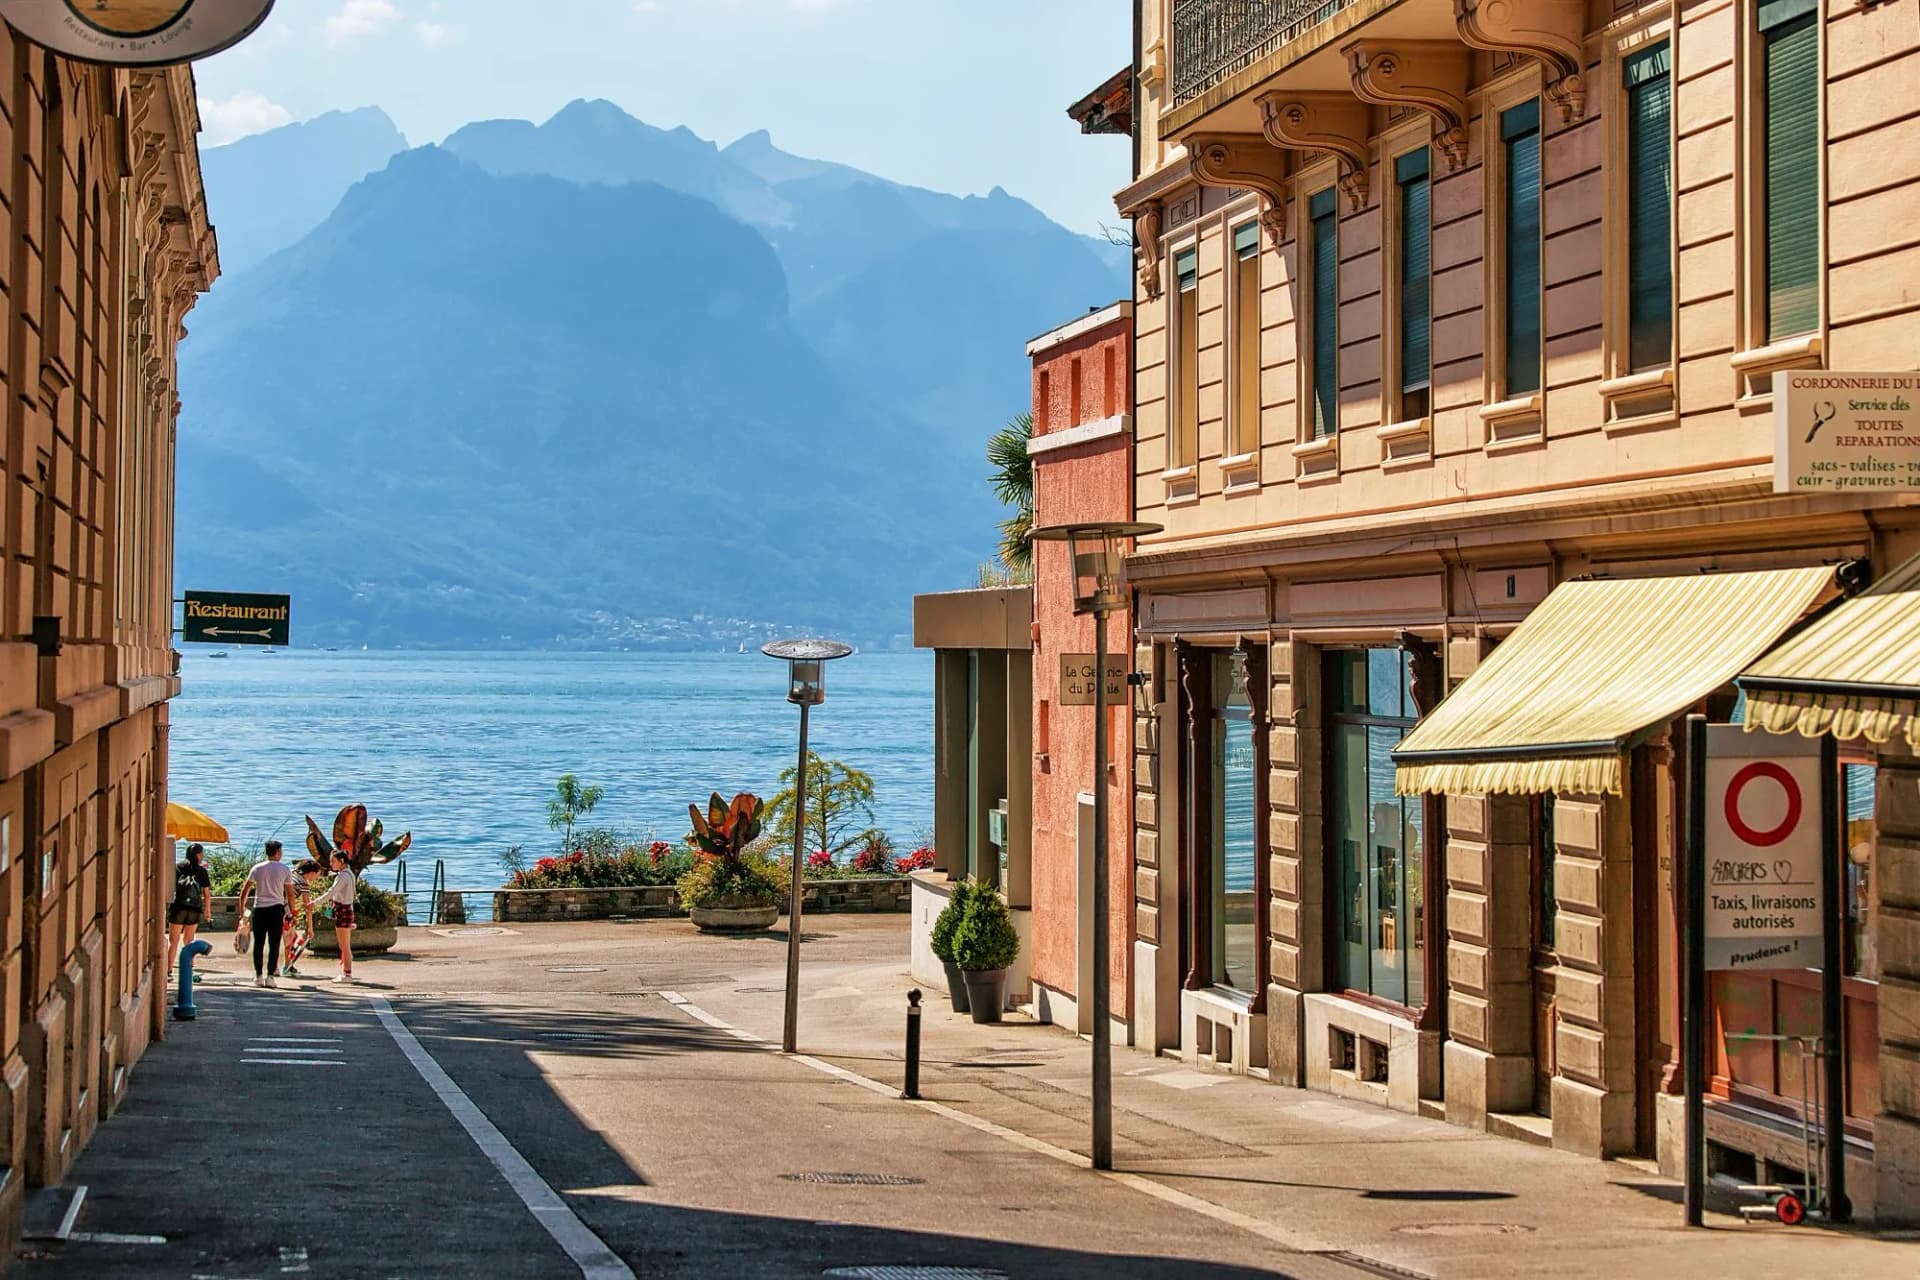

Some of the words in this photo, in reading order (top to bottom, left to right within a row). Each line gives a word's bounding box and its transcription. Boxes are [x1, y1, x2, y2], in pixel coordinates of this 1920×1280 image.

[64, 17, 115, 50] Restaurant
[129, 41, 147, 51] Bar
[160, 17, 193, 45] Lounge
[1792, 378, 1889, 389] CORDONNERIE
[1893, 378, 1912, 389] DU
[1849, 398, 1887, 411] Service
[1856, 420, 1903, 431] TOUTES
[1811, 461, 1838, 472] sacs
[1850, 455, 1896, 472] valises
[1797, 473, 1823, 486] cuir
[1835, 476, 1896, 490] gravures
[187, 600, 288, 620] Restaurant
[1066, 666, 1077, 678] La
[1068, 682, 1082, 694] du
[1712, 896, 1748, 911] Taxis,
[1752, 895, 1816, 910] livraisons
[1732, 914, 1795, 929] autorisés
